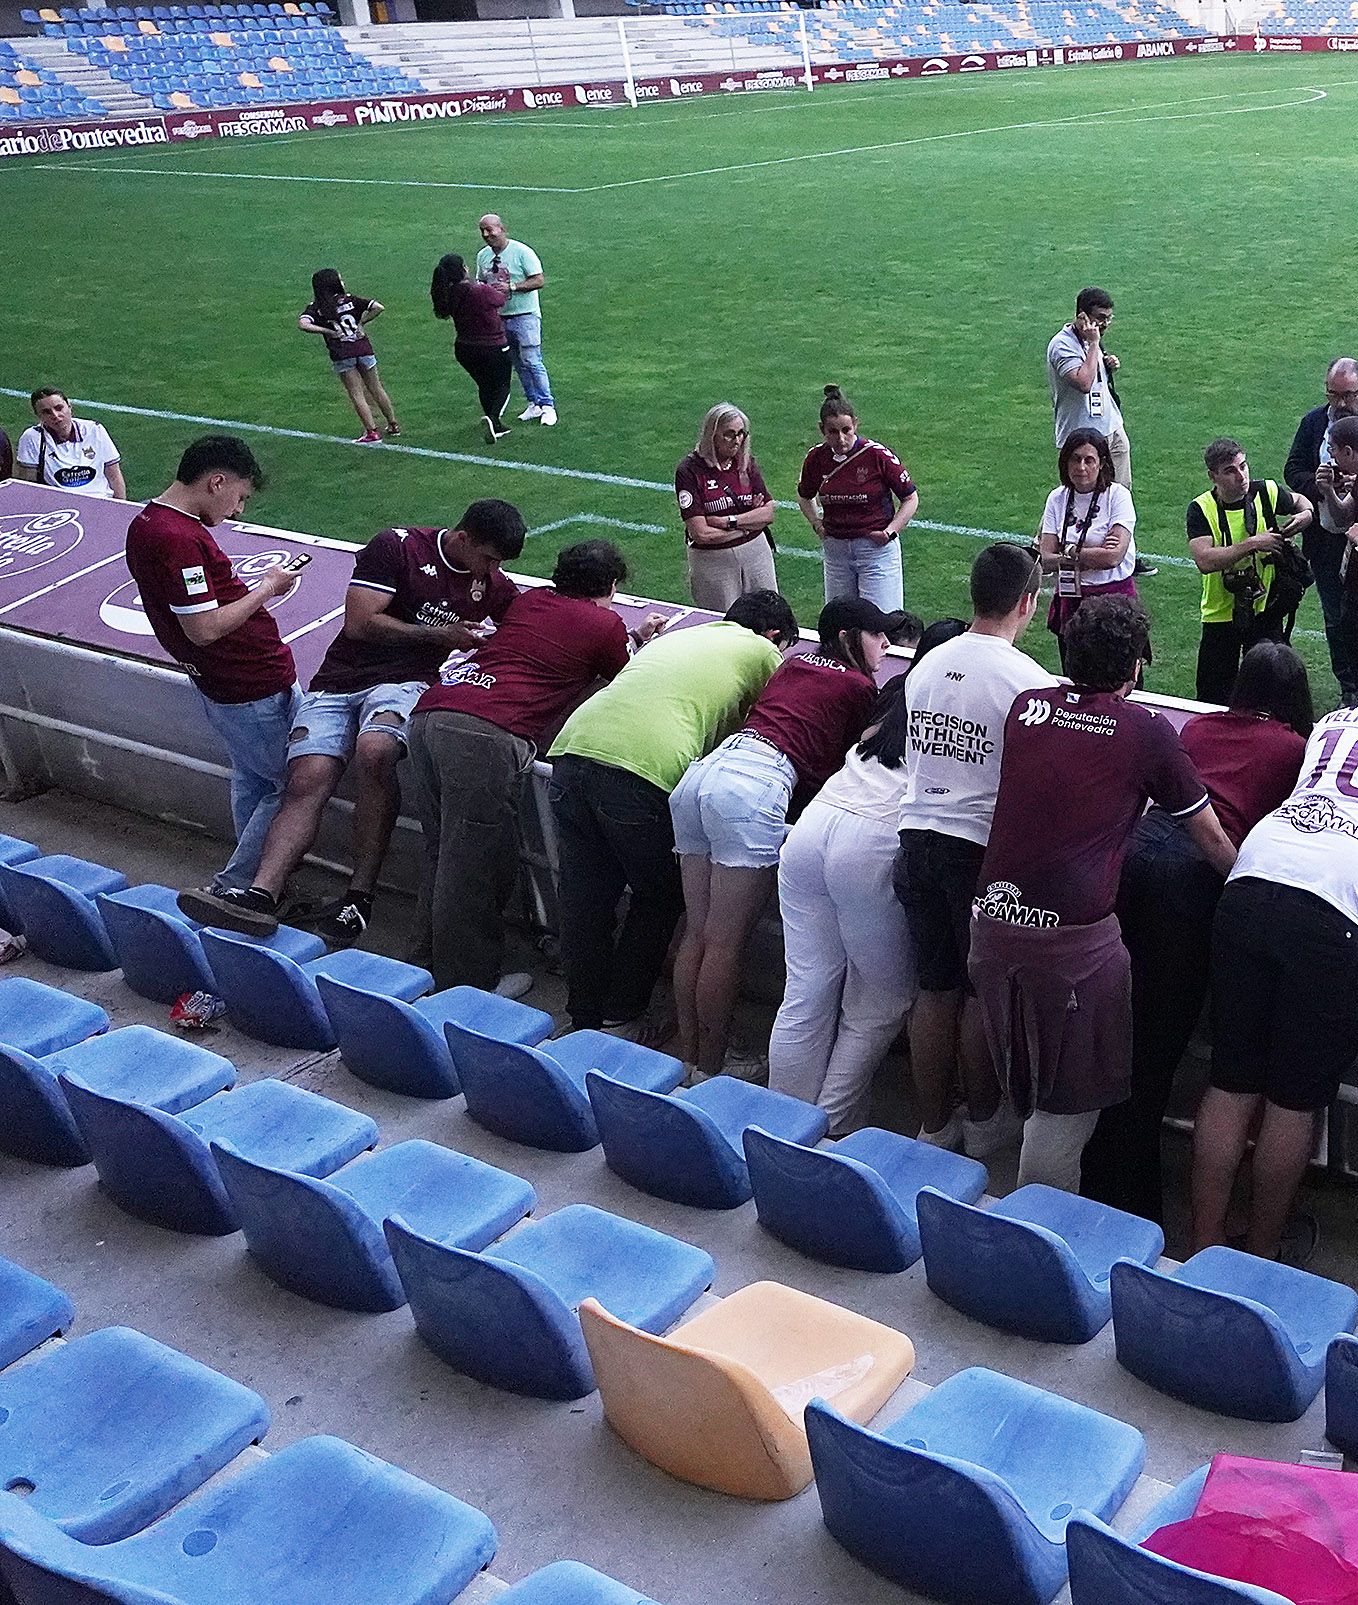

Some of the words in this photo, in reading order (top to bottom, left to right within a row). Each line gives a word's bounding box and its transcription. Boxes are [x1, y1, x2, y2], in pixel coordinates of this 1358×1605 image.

[1136, 42, 1175, 58] ABANCA
[57, 121, 168, 150] Pontevedra
[218, 116, 309, 137] PESCAMAR
[416, 610, 449, 627] Galici
[421, 602, 460, 623] Estrella
[1051, 716, 1115, 736] Pontevedra
[1055, 707, 1117, 727] Deputación
